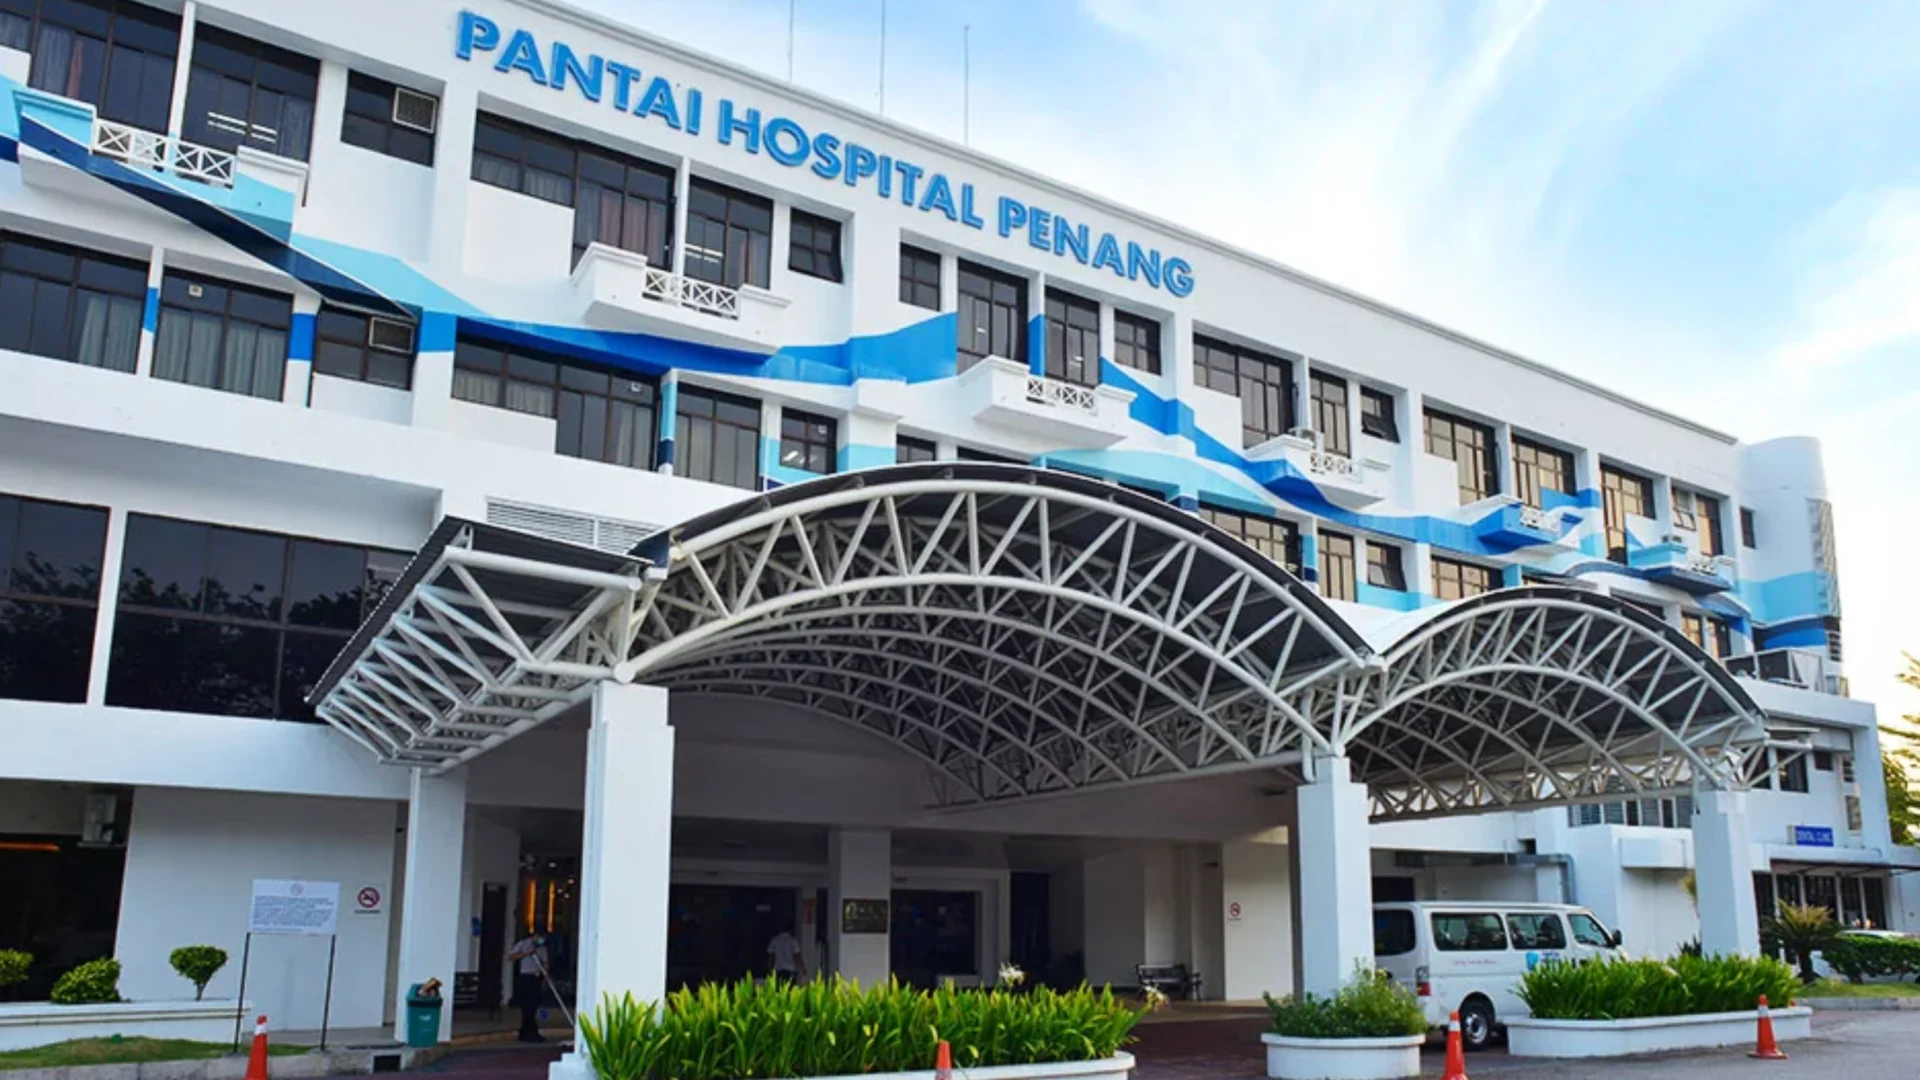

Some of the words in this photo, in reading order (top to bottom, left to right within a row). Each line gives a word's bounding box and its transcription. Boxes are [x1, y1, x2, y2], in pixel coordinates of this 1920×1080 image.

[455, 9, 703, 135] PANTAI
[716, 98, 985, 230] HOSPITAL
[997, 196, 1195, 297] PENANG
